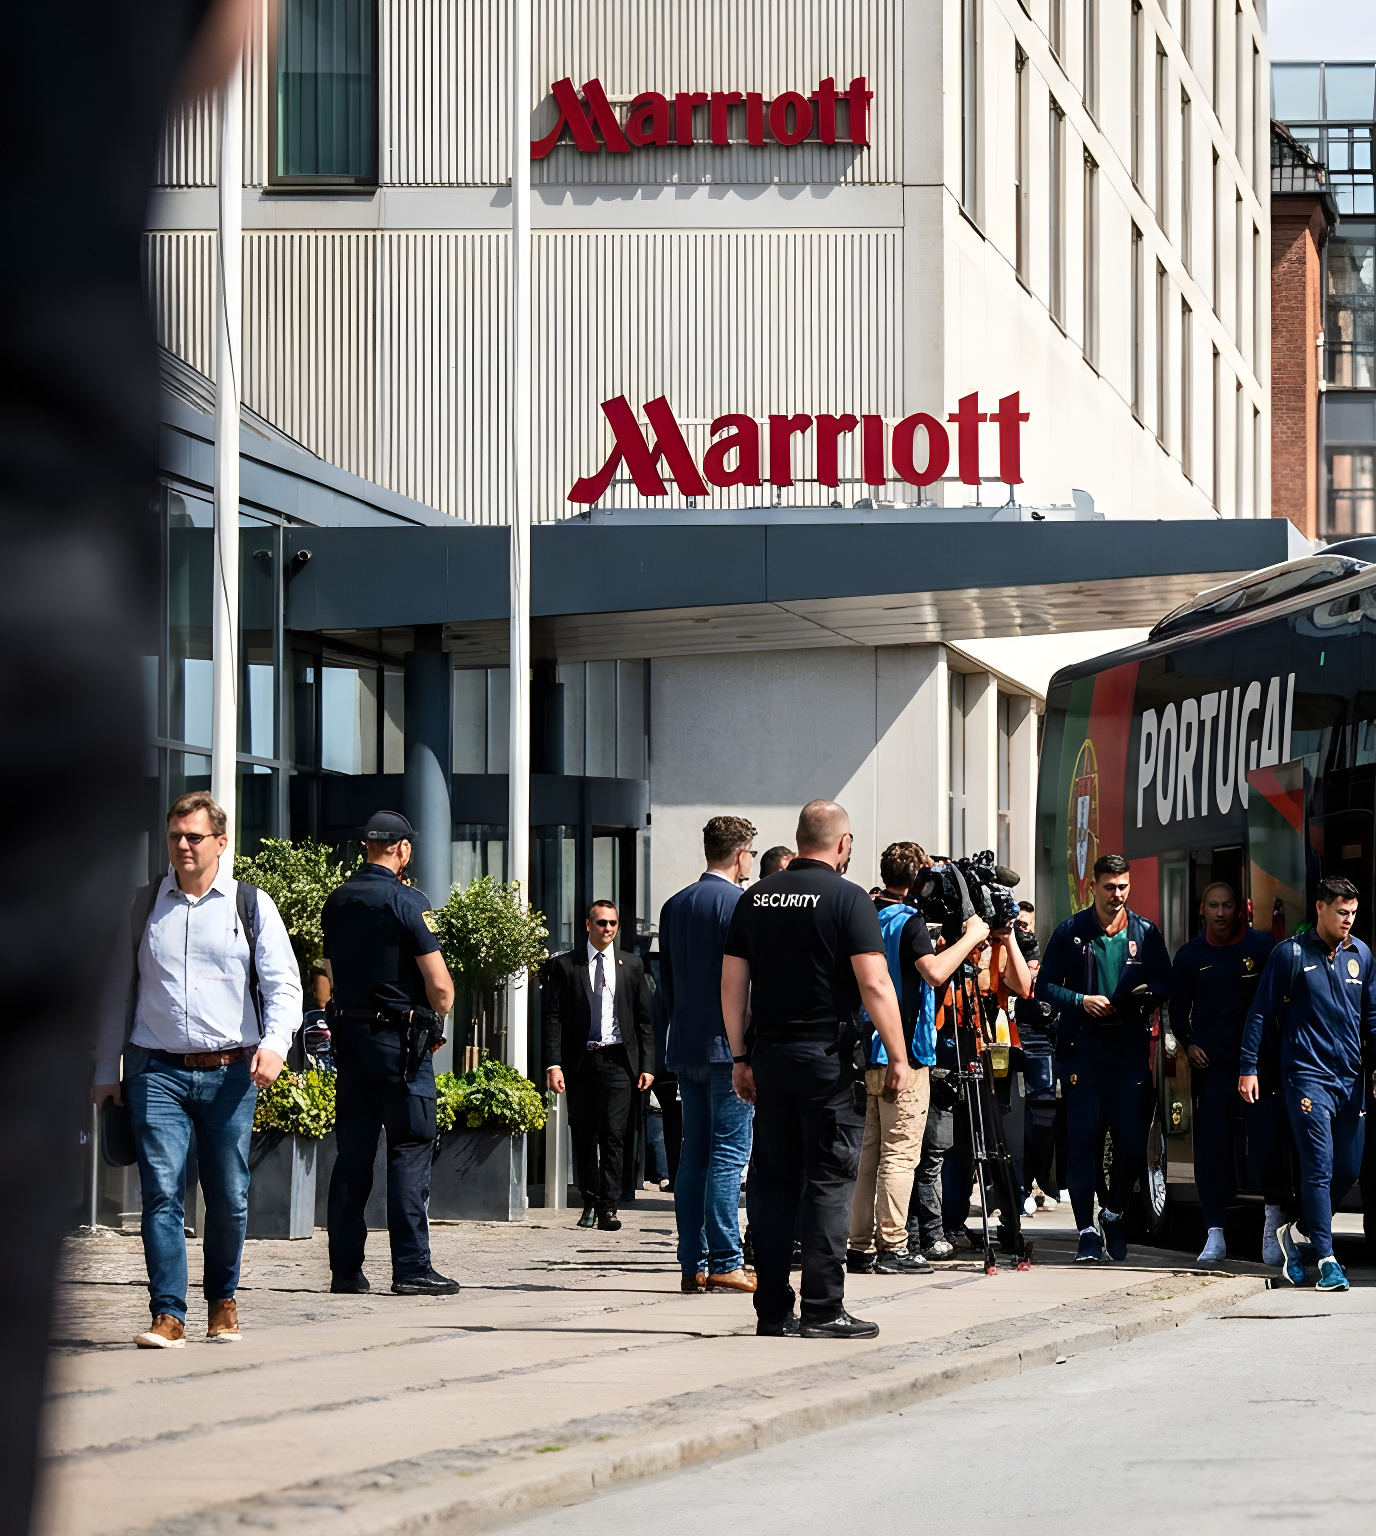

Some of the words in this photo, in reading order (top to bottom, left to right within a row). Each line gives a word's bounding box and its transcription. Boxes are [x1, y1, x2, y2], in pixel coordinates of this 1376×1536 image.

[530, 77, 874, 159] Marriott
[567, 391, 1030, 504] Marriott
[753, 893, 821, 908] SECURITY
